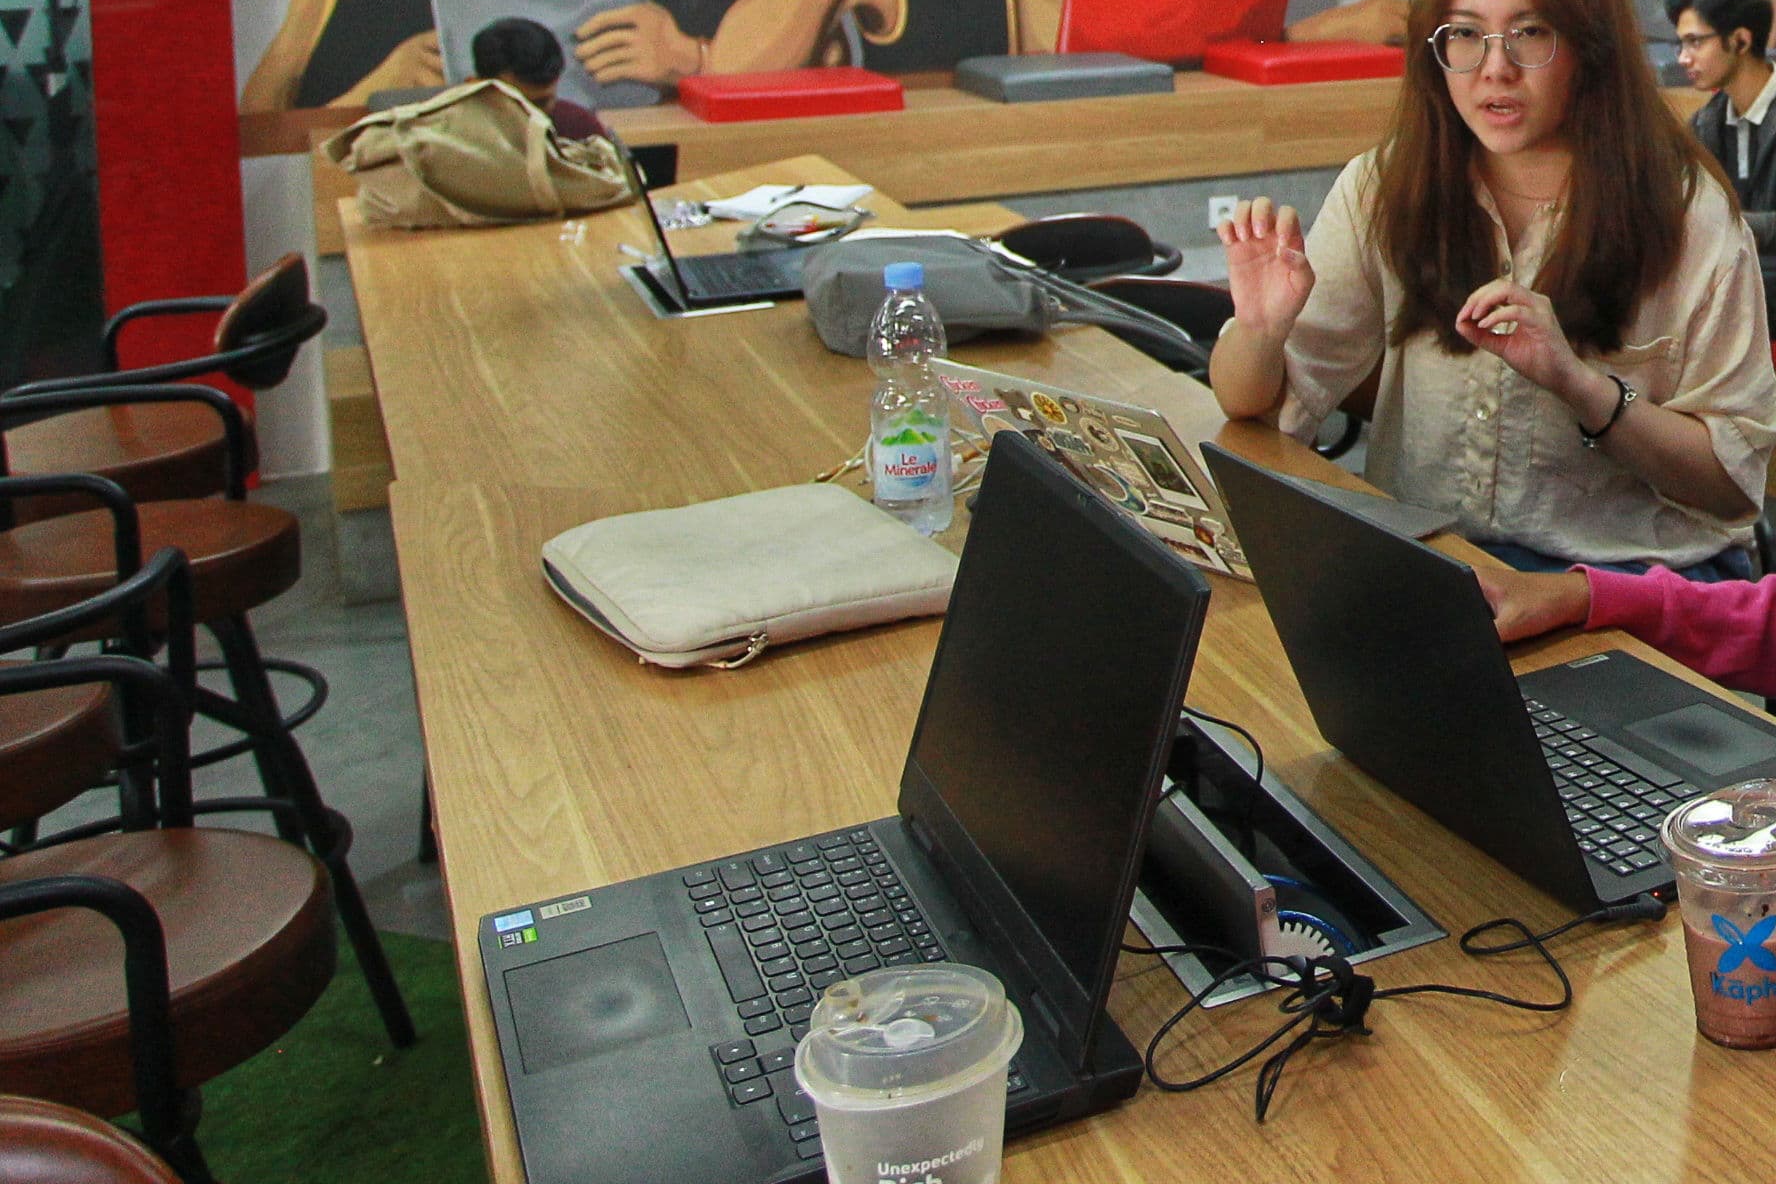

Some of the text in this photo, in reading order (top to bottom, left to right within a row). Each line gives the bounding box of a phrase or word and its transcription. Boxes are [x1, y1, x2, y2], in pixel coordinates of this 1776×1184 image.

[902, 454, 918, 465] Le
[884, 461, 937, 477] Minerale
[877, 1137, 984, 1177] Unexpectedly
